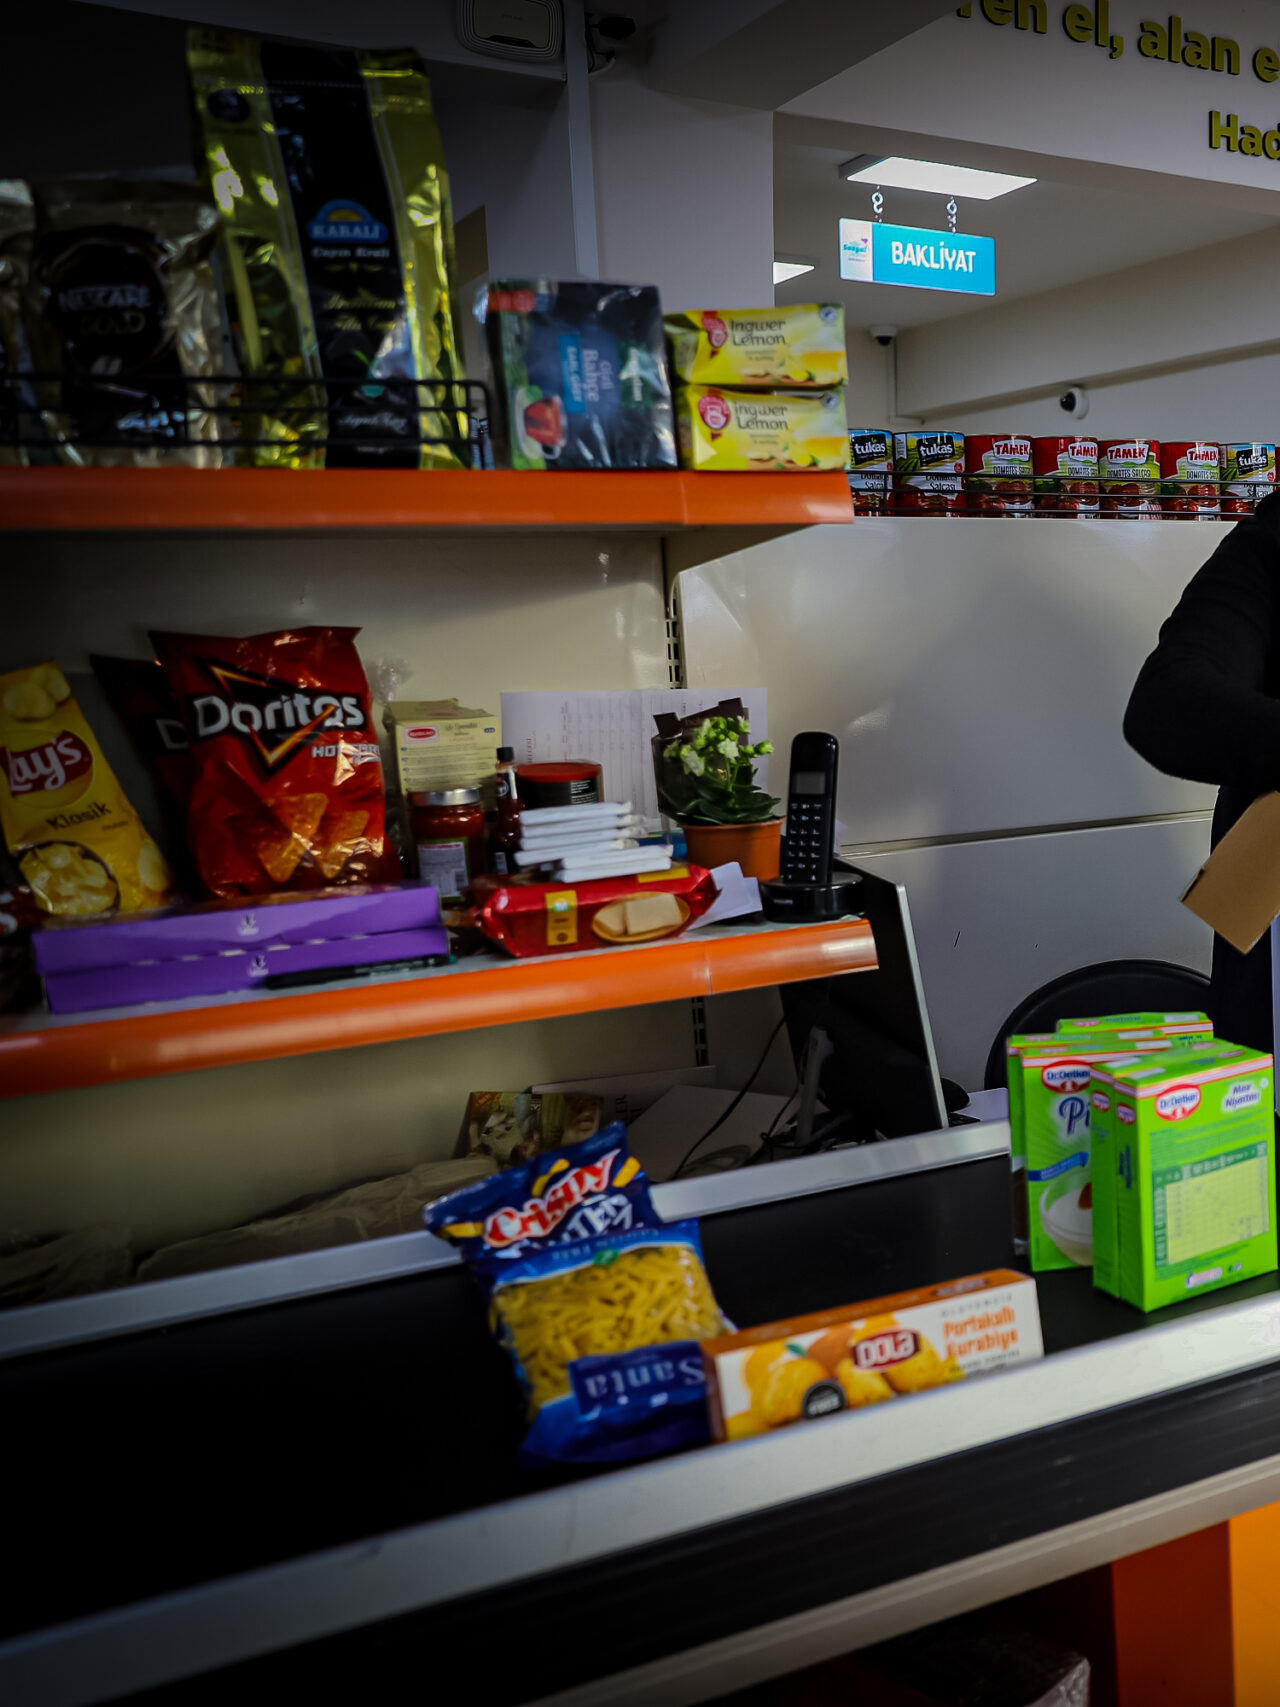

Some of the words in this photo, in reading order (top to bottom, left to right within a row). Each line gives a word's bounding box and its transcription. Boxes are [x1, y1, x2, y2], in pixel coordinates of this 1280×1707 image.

[1138, 15, 1240, 75] alan
[891, 241, 976, 273] BAKLİYAT
[732, 333, 786, 346] Lemon
[737, 417, 789, 430] Lemon
[995, 443, 1029, 455] TAMEK
[1108, 447, 1146, 459] TAMEK
[193, 694, 366, 738] Doritos
